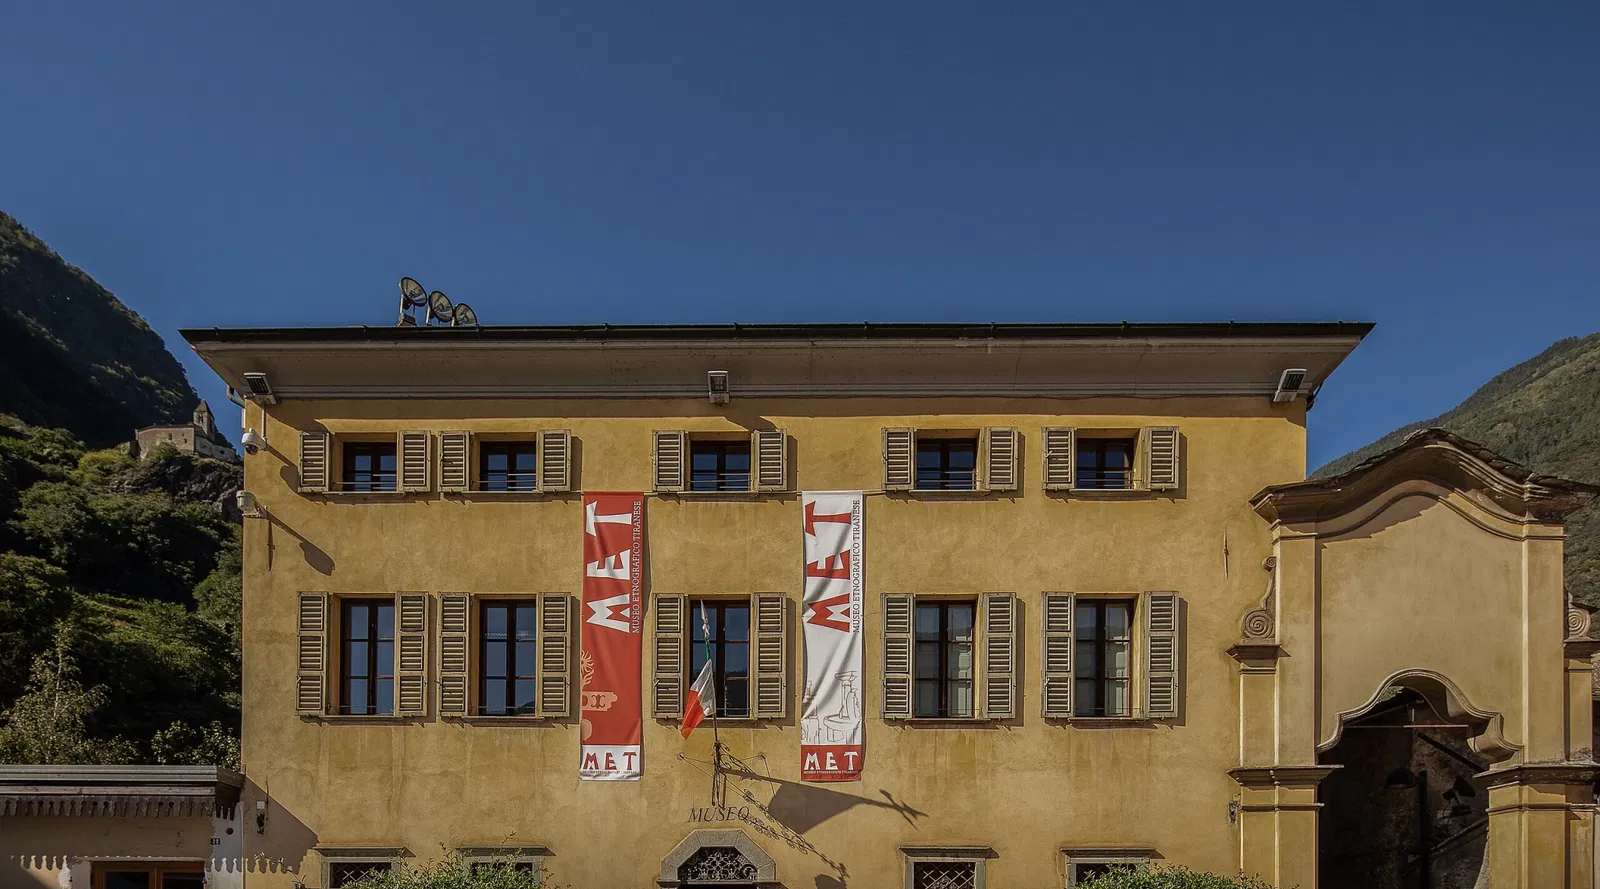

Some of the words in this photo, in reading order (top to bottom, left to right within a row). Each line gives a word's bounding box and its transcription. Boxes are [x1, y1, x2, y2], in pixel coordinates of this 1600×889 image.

[633, 500, 642, 541] TIRANESE
[852, 500, 860, 541] TIRANESE
[585, 500, 632, 633] MET
[632, 542, 641, 601] ETNOGRAFICO
[804, 500, 851, 633] MET
[852, 542, 860, 601] ETNOGRAFICO
[632, 604, 640, 634] MUSEO
[852, 604, 860, 633] MUSEO
[583, 751, 637, 770] MET
[803, 751, 859, 771] MET
[688, 806, 750, 822] MUSEO
